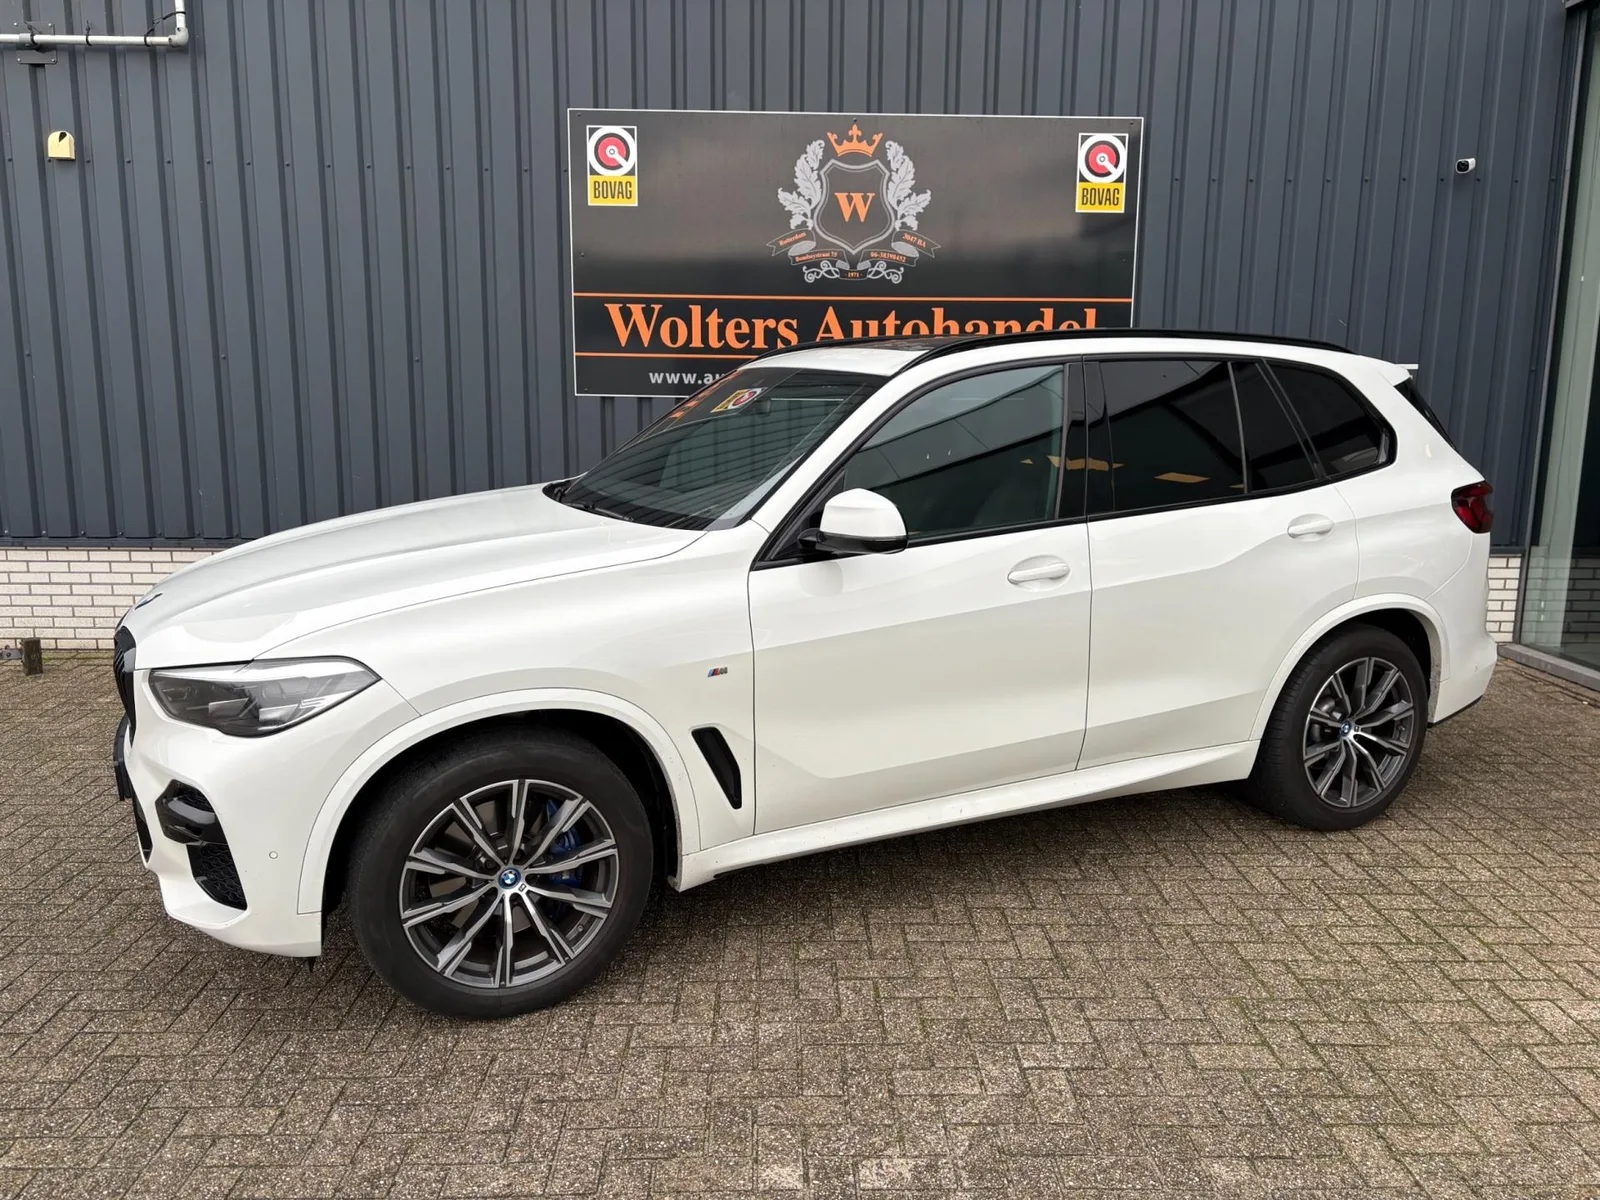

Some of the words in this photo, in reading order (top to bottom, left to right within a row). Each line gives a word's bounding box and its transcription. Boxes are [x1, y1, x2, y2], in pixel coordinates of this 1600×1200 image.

[593, 180, 633, 200] BOVAG
[1081, 187, 1120, 207] BOVAG
[834, 192, 876, 223] W
[603, 303, 800, 350] Wolters
